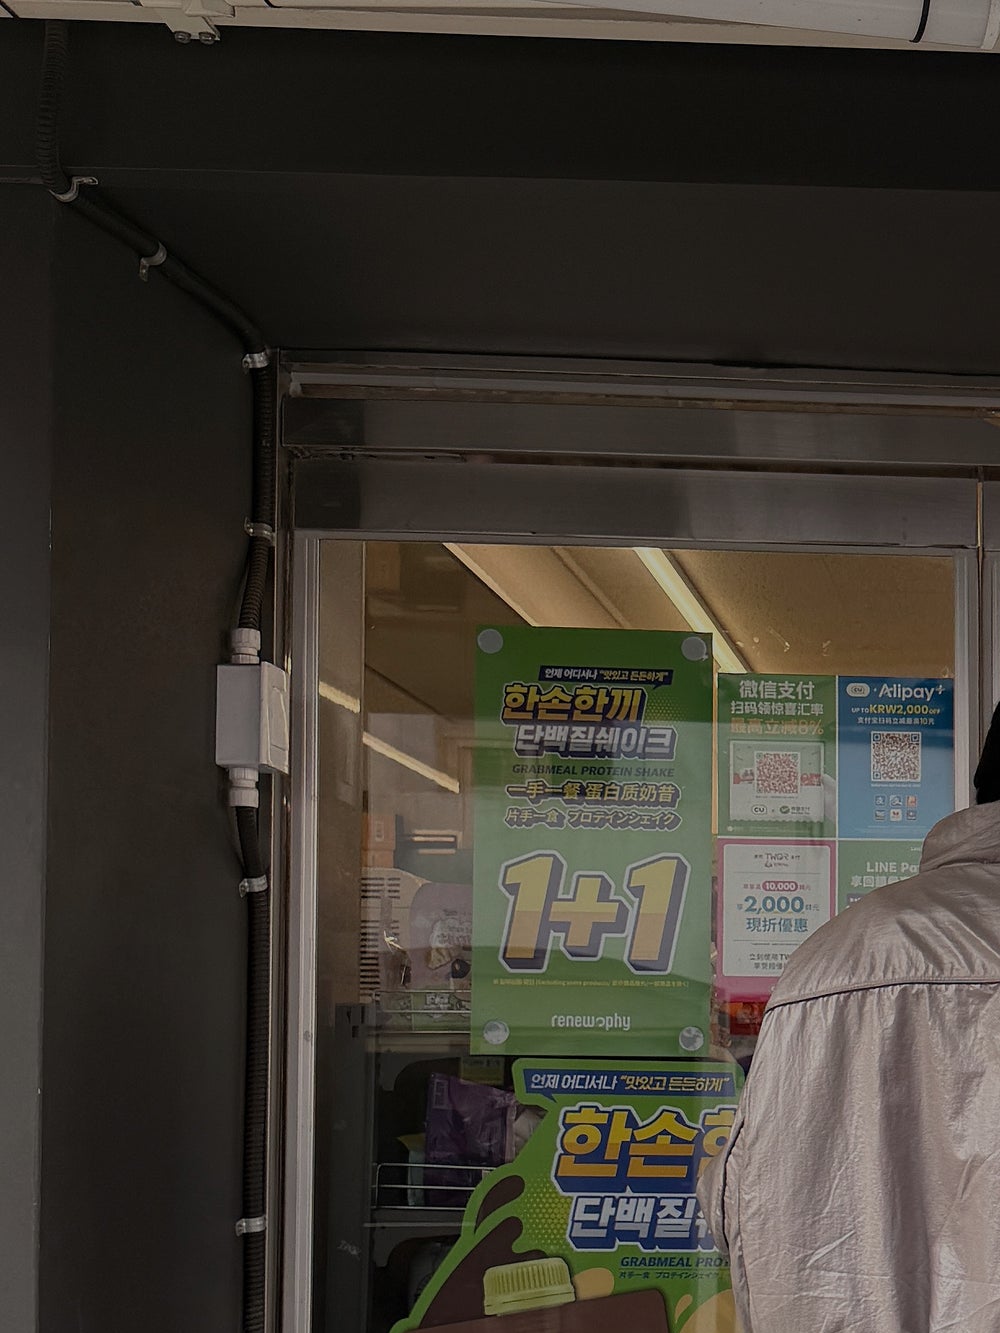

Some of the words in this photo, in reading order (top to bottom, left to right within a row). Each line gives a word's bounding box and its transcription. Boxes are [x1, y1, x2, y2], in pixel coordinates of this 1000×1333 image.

[544, 668, 562, 679] 언제
[563, 669, 598, 680] 어디서나
[739, 680, 815, 700] 微信支付
[879, 683, 945, 702] Alipay+
[502, 683, 642, 723] 한손한끼
[730, 701, 824, 717] 扫码领惊喜汇率
[869, 704, 929, 715] KRW2,000
[730, 718, 824, 735] 最高立减8%
[517, 725, 671, 754] 단백질쉐이크
[512, 764, 577, 775] GRABMEAL
[581, 765, 633, 776] PROTEIN
[634, 767, 675, 778] SHAKE
[585, 782, 675, 802] 蛋白质奶昔
[505, 808, 559, 823] 片手一食
[568, 811, 675, 826] プロテインシェイク
[866, 861, 897, 872] LINE
[503, 856, 679, 961] 1+1
[744, 896, 805, 915] 2,000
[746, 917, 809, 933] 現折優惠
[531, 1074, 560, 1089] 언제
[561, 1074, 617, 1090] 어디서나
[621, 1257, 693, 1268] GRABMEAL
